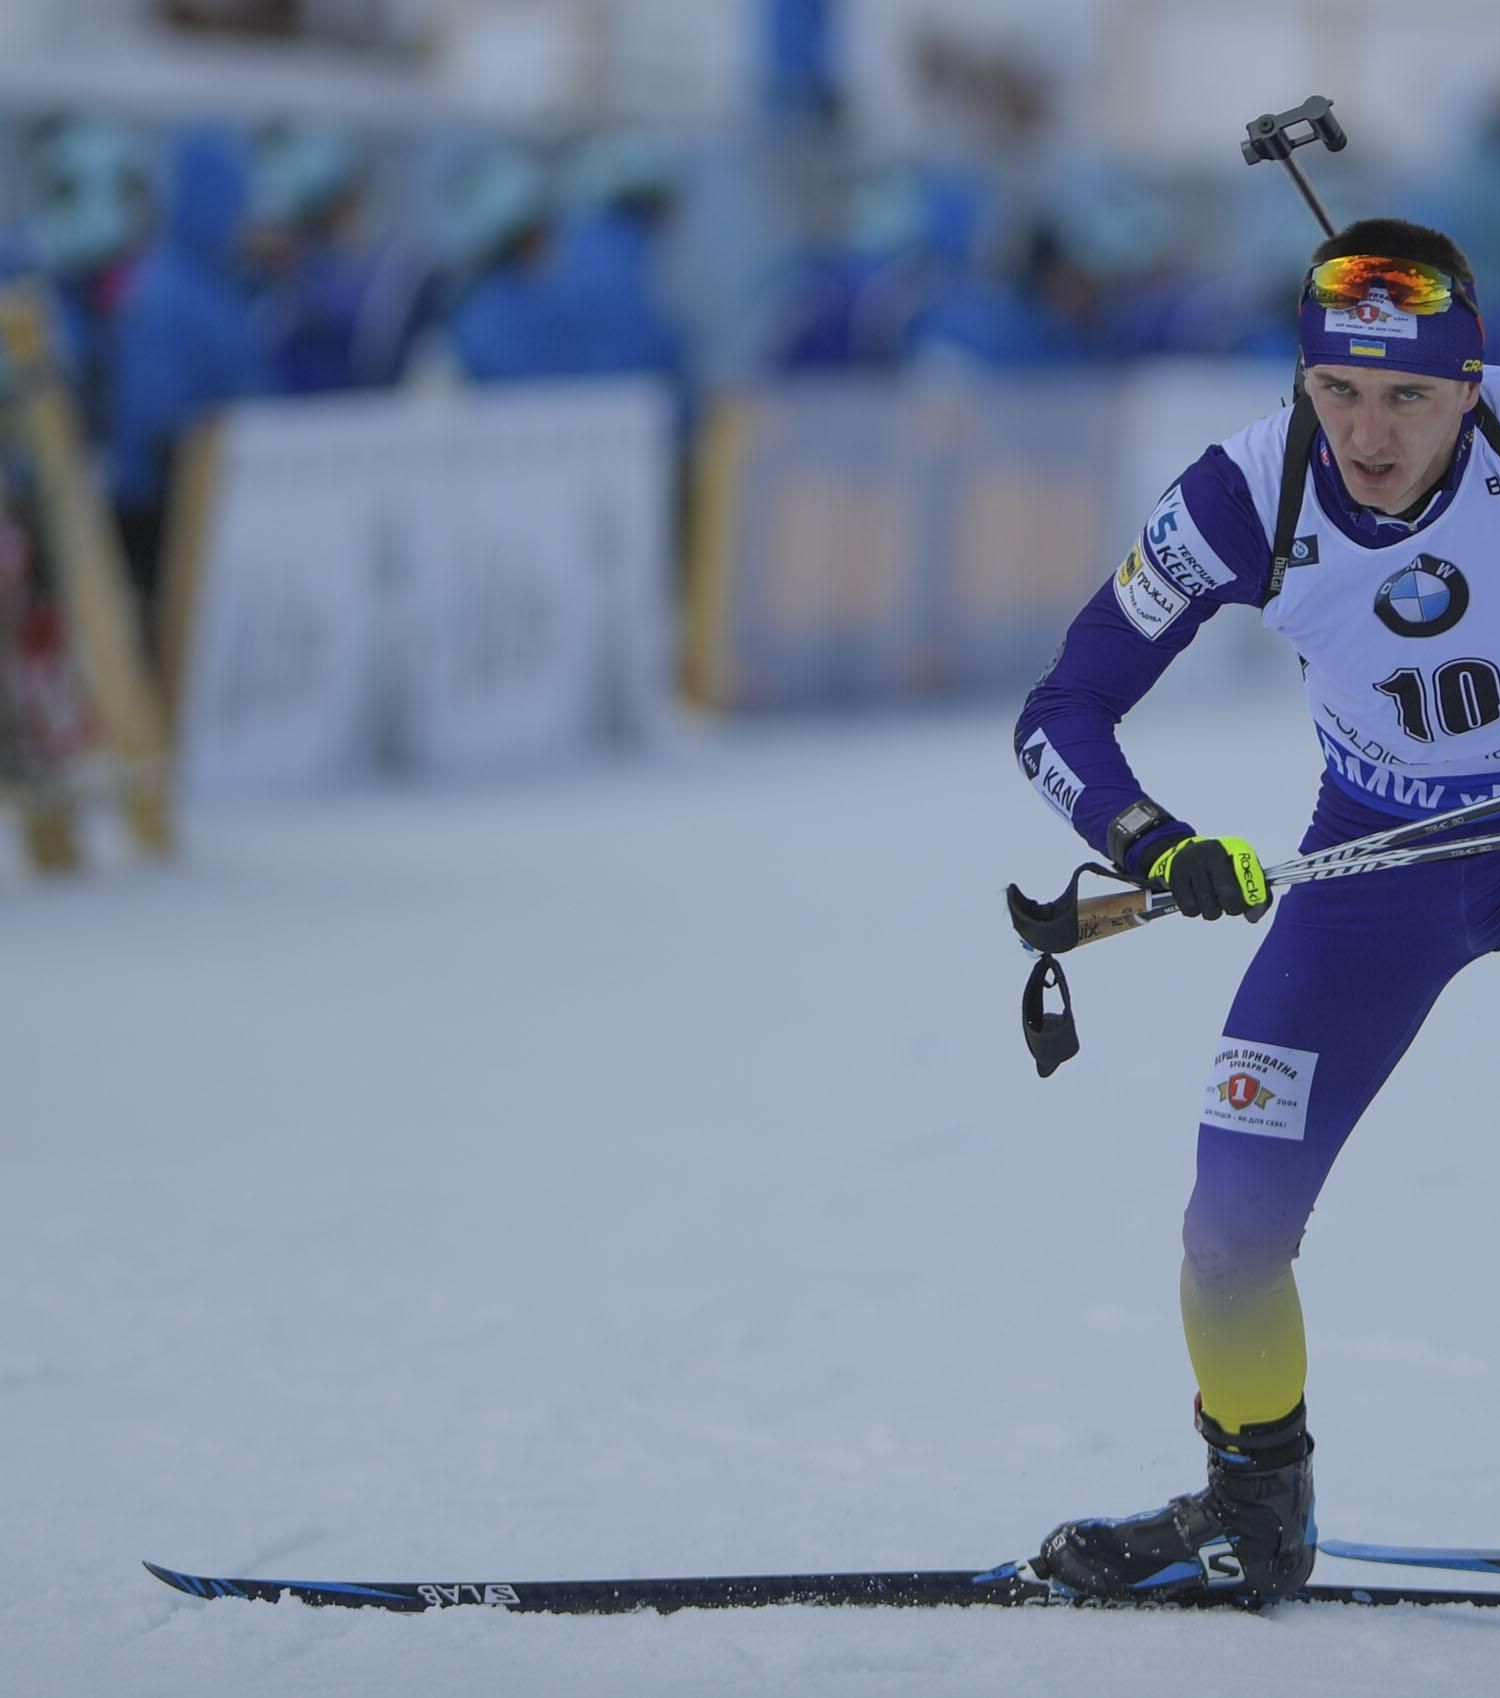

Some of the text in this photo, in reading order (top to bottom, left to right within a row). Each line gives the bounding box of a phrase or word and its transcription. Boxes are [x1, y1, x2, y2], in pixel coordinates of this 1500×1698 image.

[1461, 358, 1482, 373] CR
[1042, 764, 1077, 812] KAN
[1232, 1078, 1248, 1102] 1
